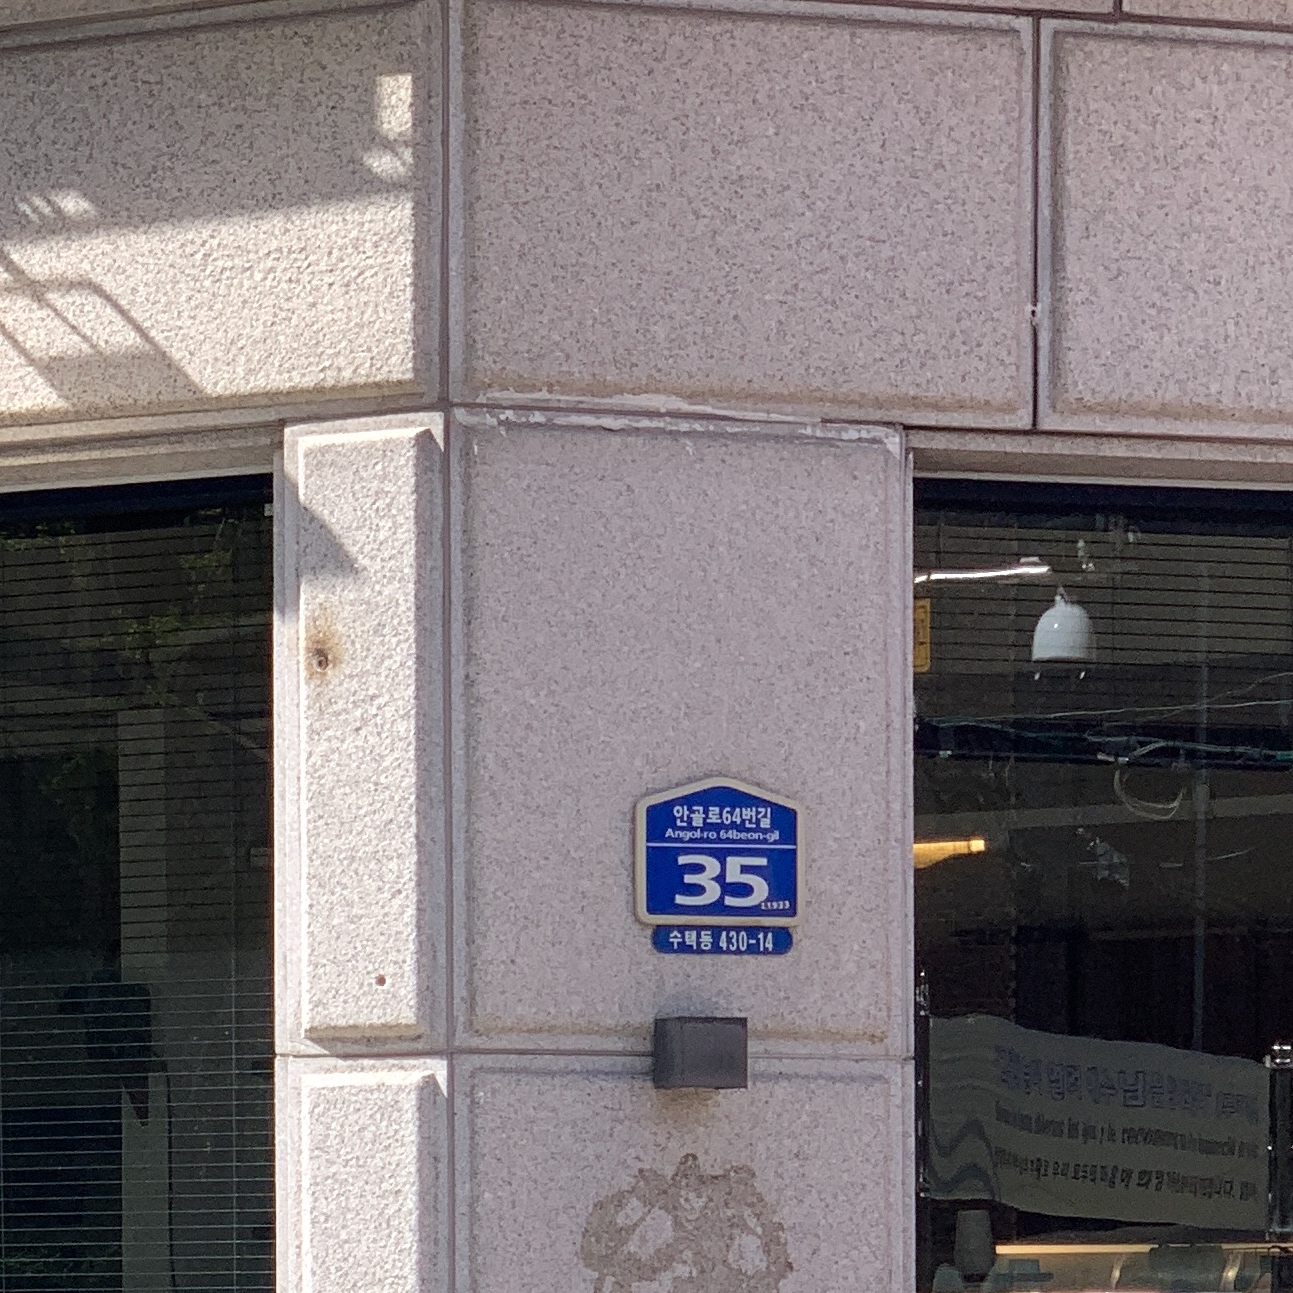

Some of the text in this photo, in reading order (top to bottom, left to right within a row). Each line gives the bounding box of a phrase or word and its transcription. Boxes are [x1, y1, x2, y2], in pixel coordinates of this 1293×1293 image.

[673, 805, 771, 828] 안골로64번길
[665, 828, 780, 843] Angol-ro 64beon-gil
[674, 854, 769, 907] 35
[669, 930, 773, 952] 수택동 430-14
